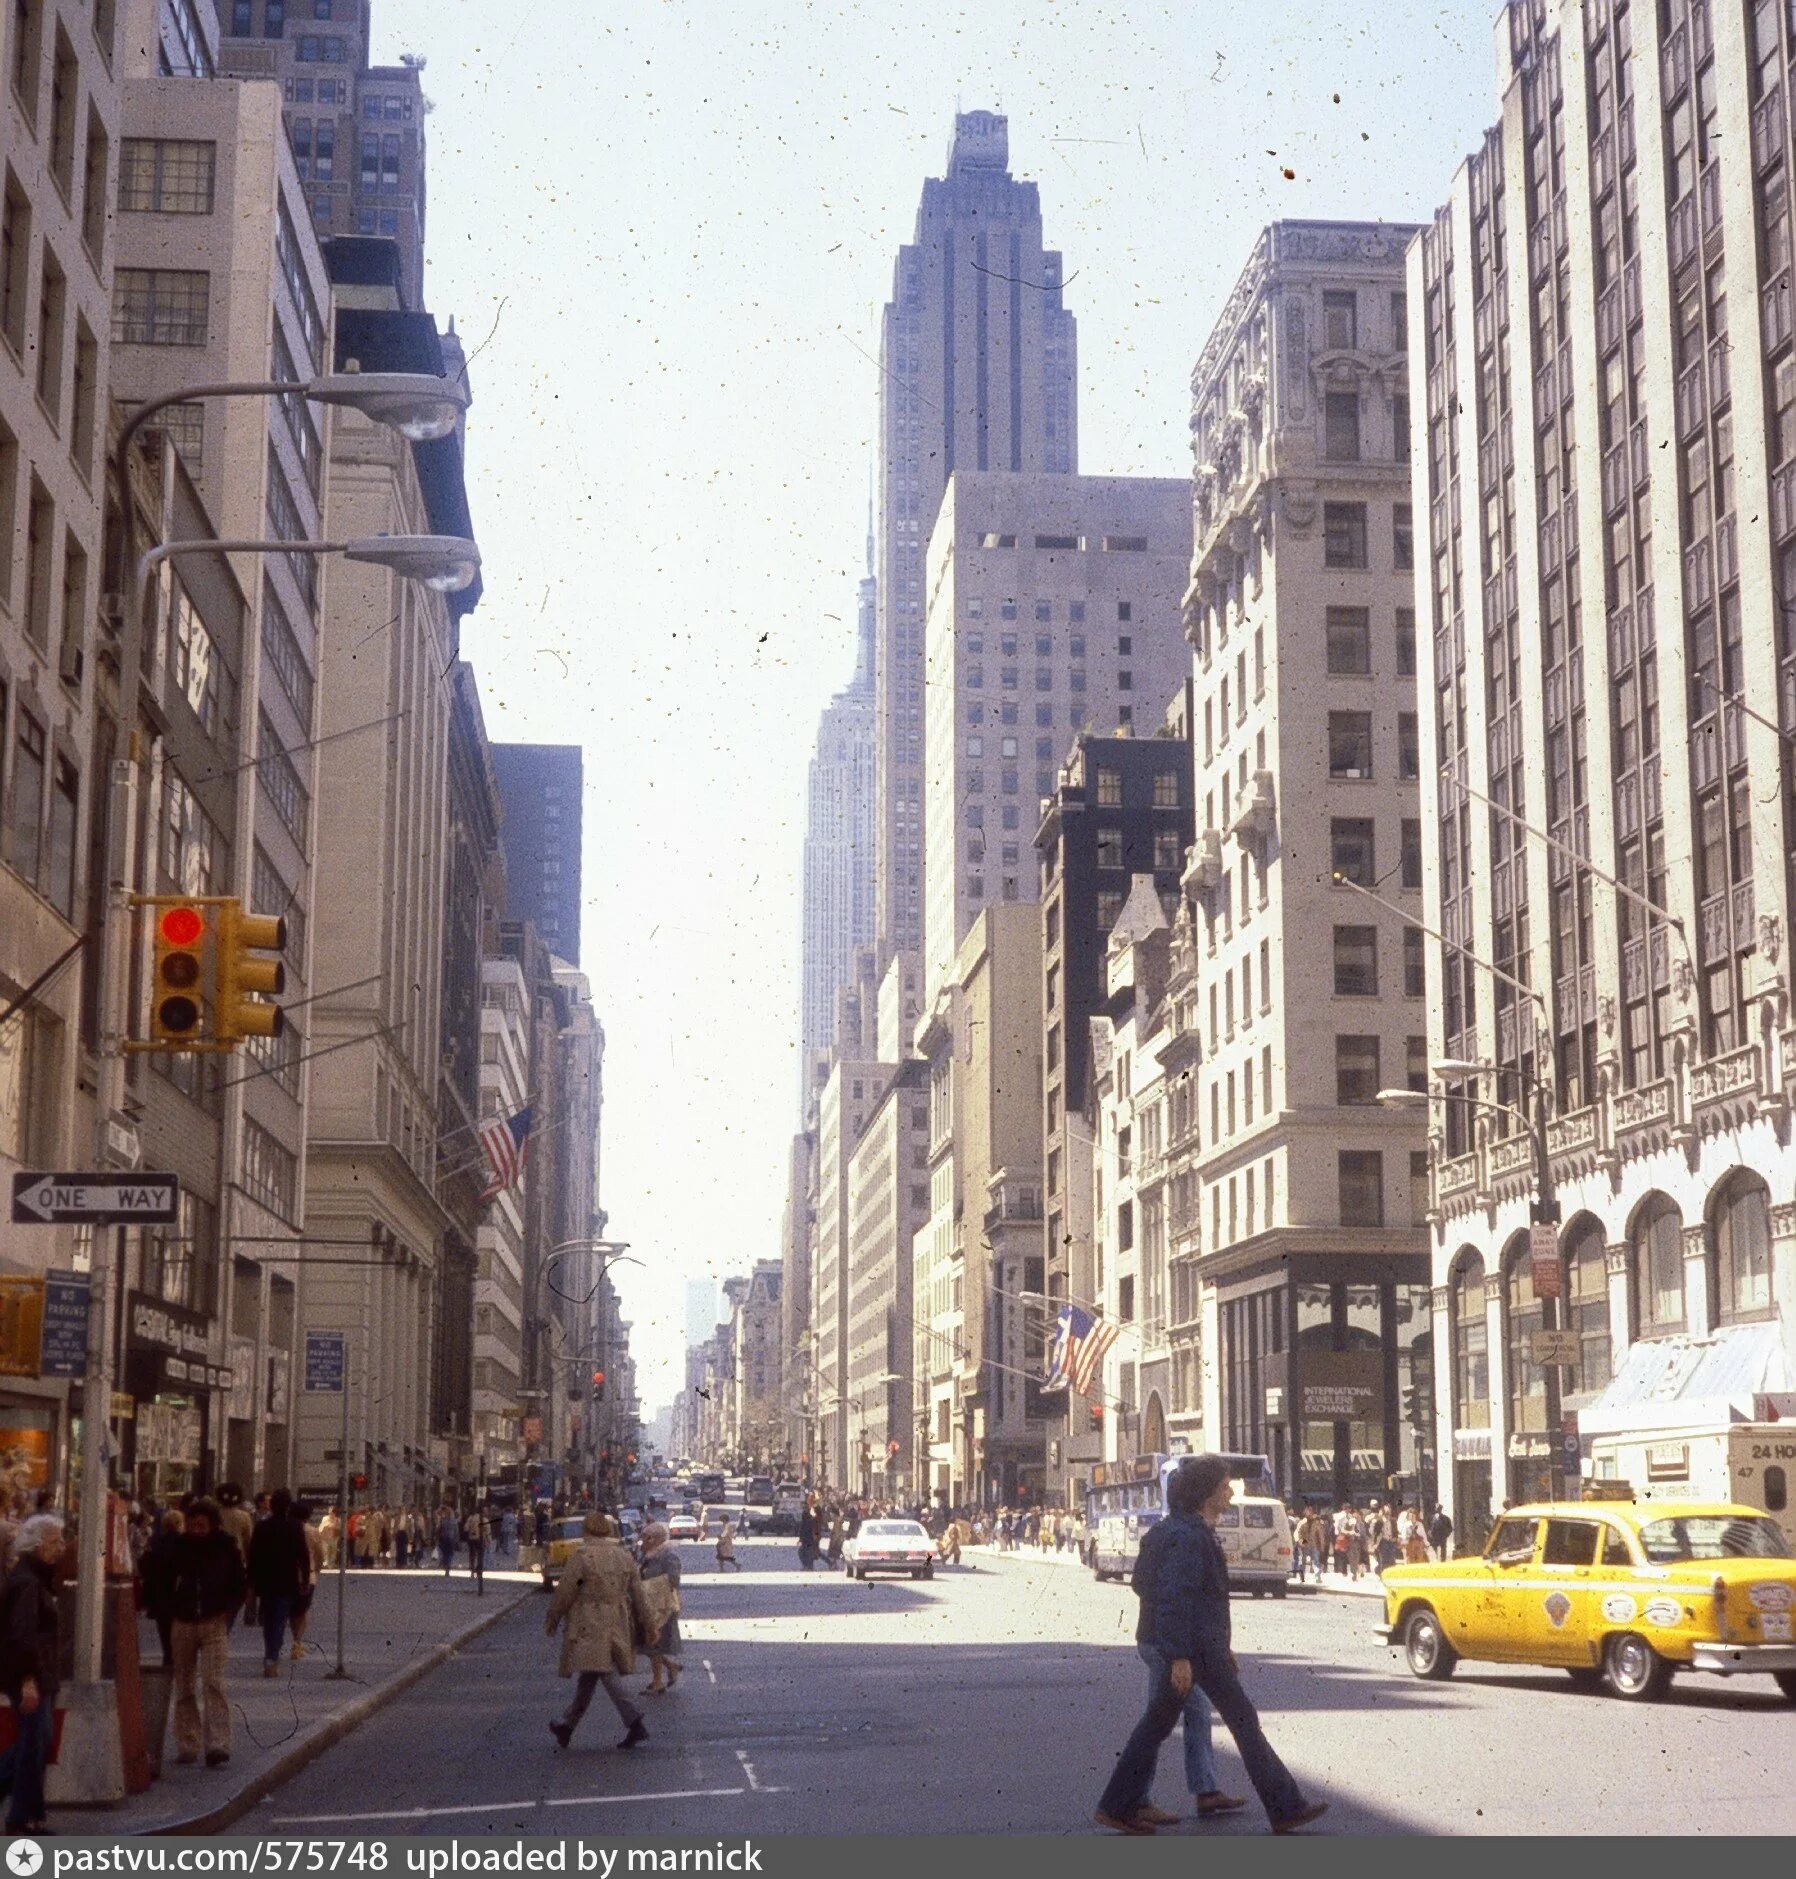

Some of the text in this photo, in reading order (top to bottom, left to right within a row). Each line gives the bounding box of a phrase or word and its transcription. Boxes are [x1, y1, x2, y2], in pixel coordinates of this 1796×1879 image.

[38, 1188, 166, 1209] ONE WAY
[1533, 1239, 1555, 1247] AWAY
[1533, 1247, 1556, 1256] ZONE
[60, 1289, 75, 1301] NO
[48, 1303, 86, 1317] PARKING
[1548, 1334, 1563, 1343] NO
[1303, 1386, 1375, 1396] INTERNATIONAL
[1304, 1395, 1354, 1405] JEWELERS
[1304, 1404, 1356, 1414] EXCHANGE
[1752, 1445, 1772, 1459] 24
[1737, 1467, 1754, 1478] 47
